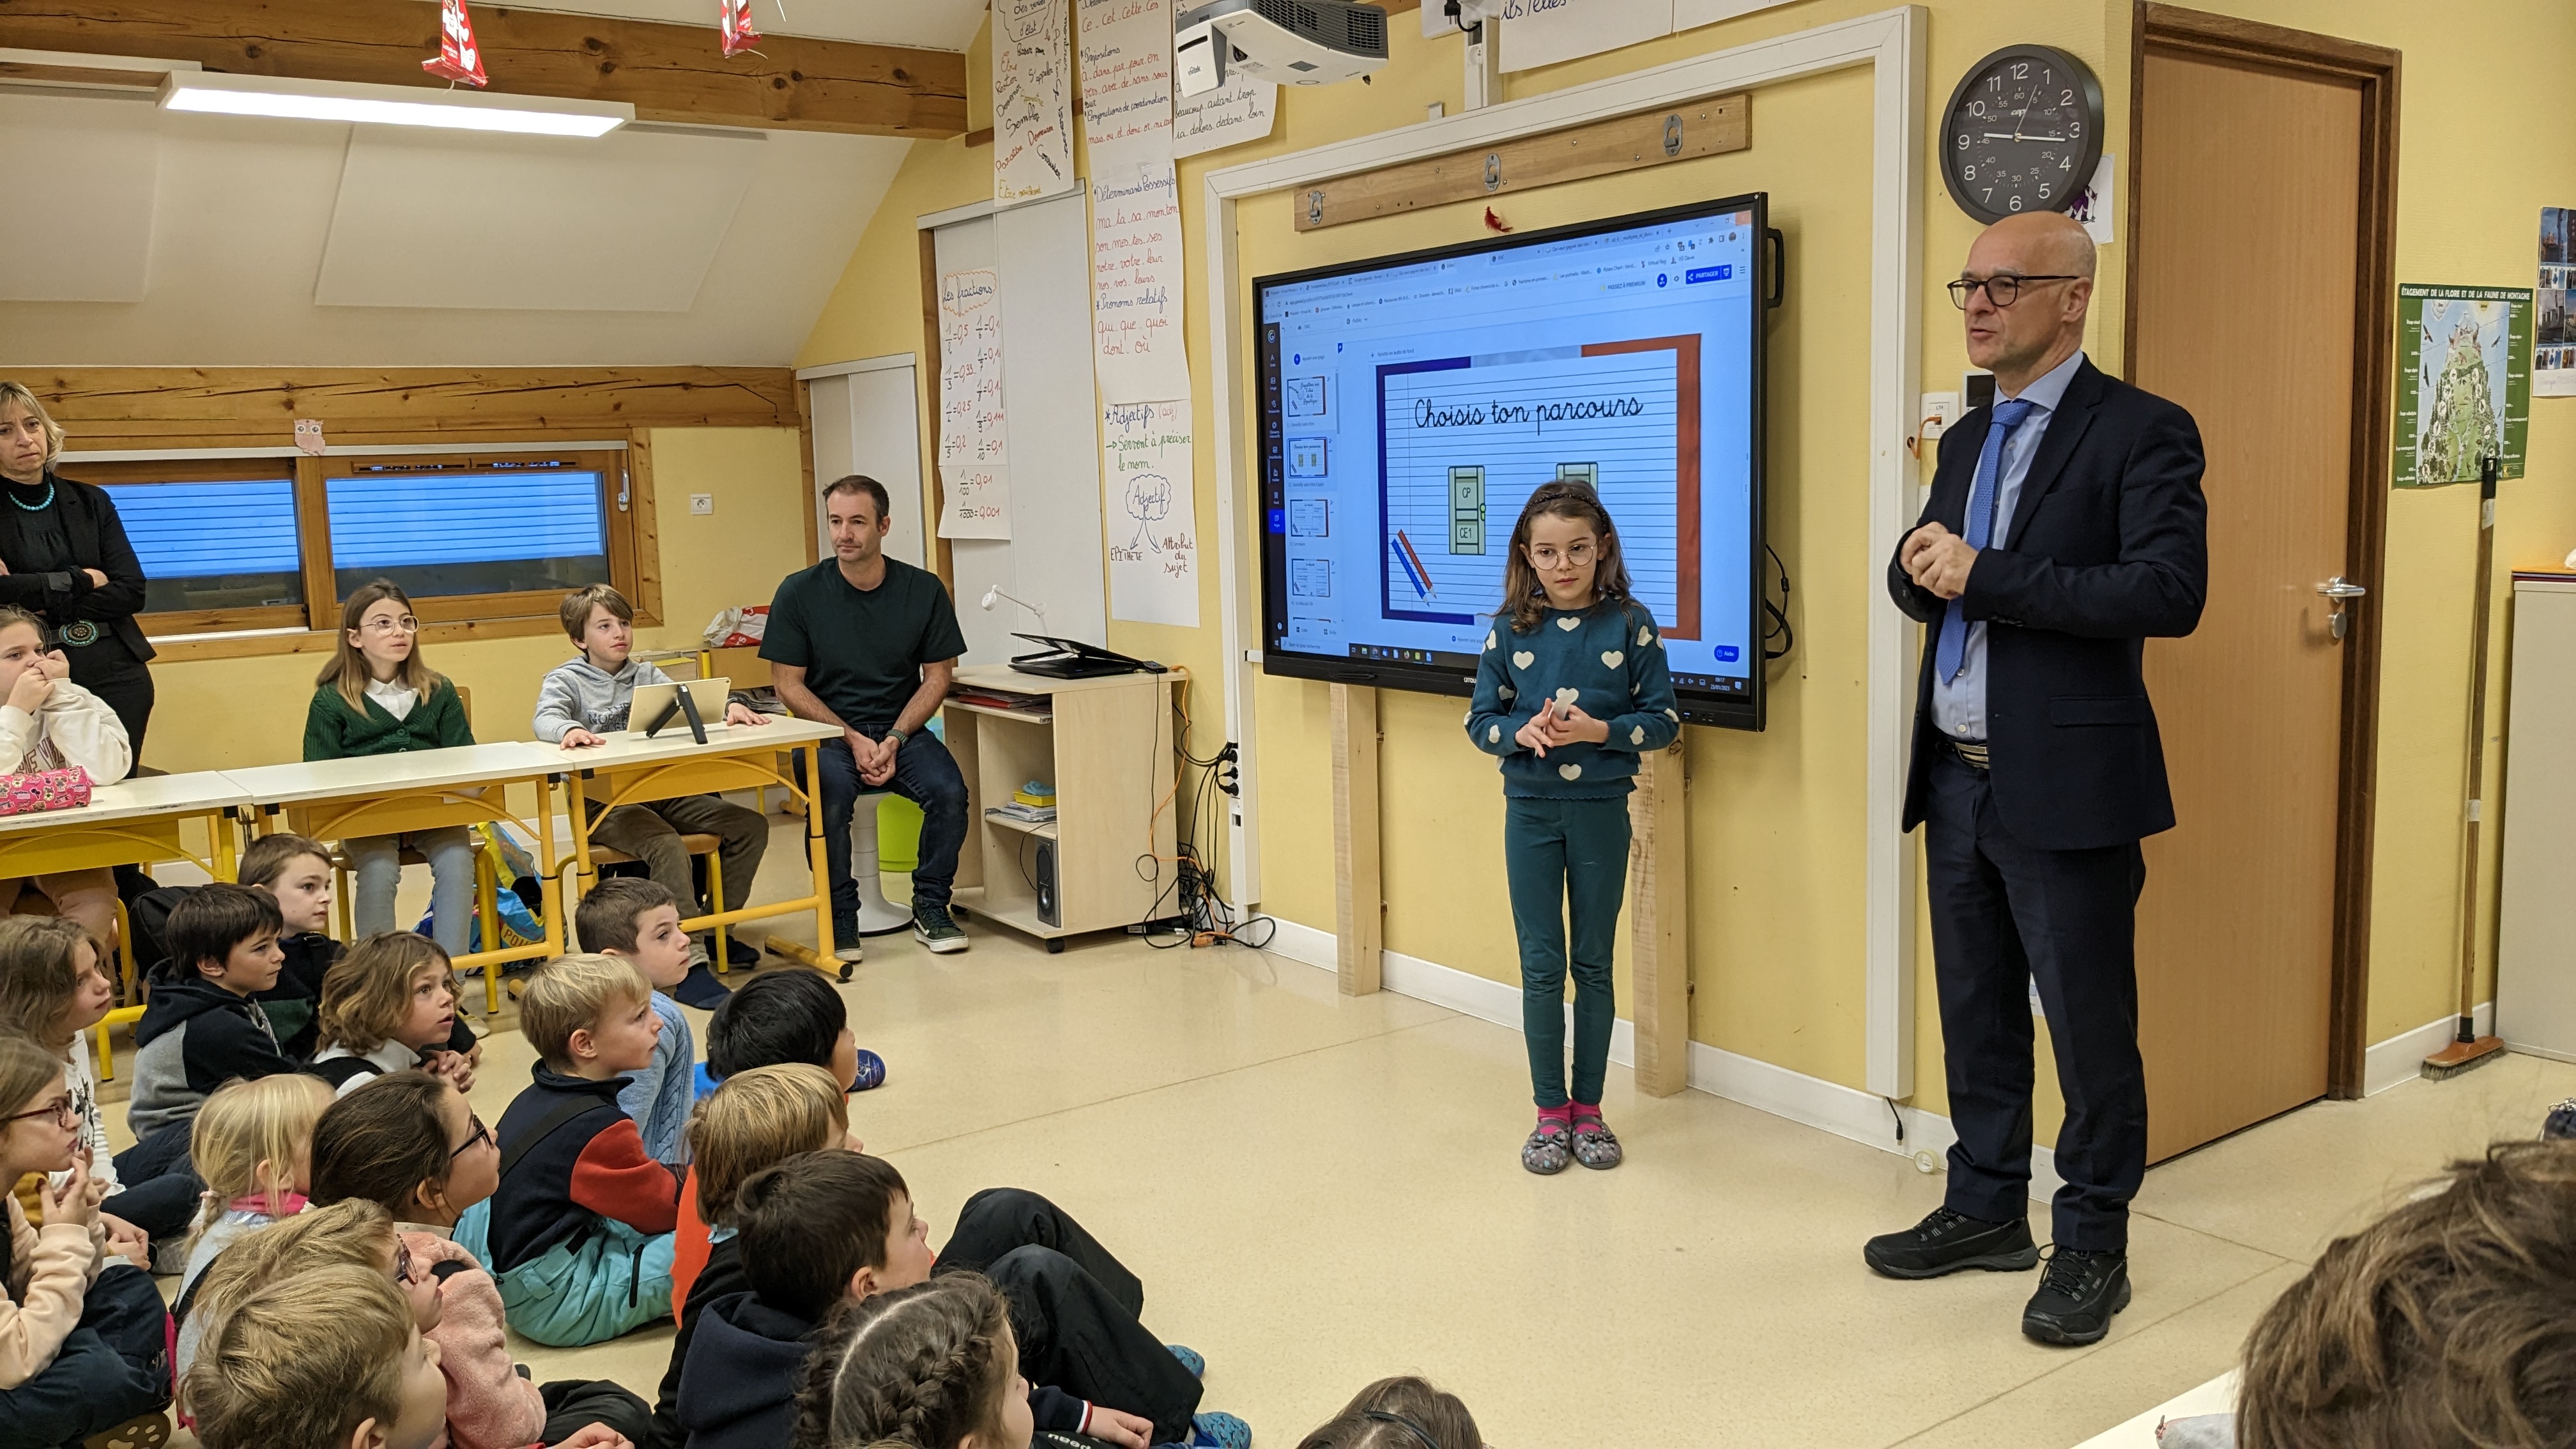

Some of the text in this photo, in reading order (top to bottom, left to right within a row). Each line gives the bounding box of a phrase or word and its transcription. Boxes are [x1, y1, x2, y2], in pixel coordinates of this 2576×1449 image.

[2010, 63, 2028, 80] 12
[2043, 69, 2051, 84] 1
[1986, 76, 2000, 92] 11
[1175, 88, 1257, 121] beaucoup autant trop
[2060, 89, 2073, 106] 2
[1966, 100, 1985, 117] 10
[2069, 122, 2081, 139] 3
[1958, 135, 1970, 150] 9
[2059, 156, 2071, 172] 4
[1964, 165, 1975, 181] 8
[1982, 188, 1993, 204] 7
[2038, 183, 2050, 199] 5
[2009, 195, 2021, 211] 6
[1119, 254, 1140, 269] votre
[1134, 268, 1155, 284] leurs
[1695, 270, 1719, 279] PARTAGER
[2401, 286, 2428, 296] ÉTAGEMENT
[2468, 290, 2475, 298] DE
[2507, 292, 2531, 300] MONTAGNE
[1415, 397, 1644, 436] Choisis ton parcours
[1158, 429, 1192, 458] préciser
[1132, 483, 1166, 514] Adjectif
[1462, 487, 1471, 498] CP
[1459, 528, 1473, 539] CE1
[1174, 551, 1187, 560] du
